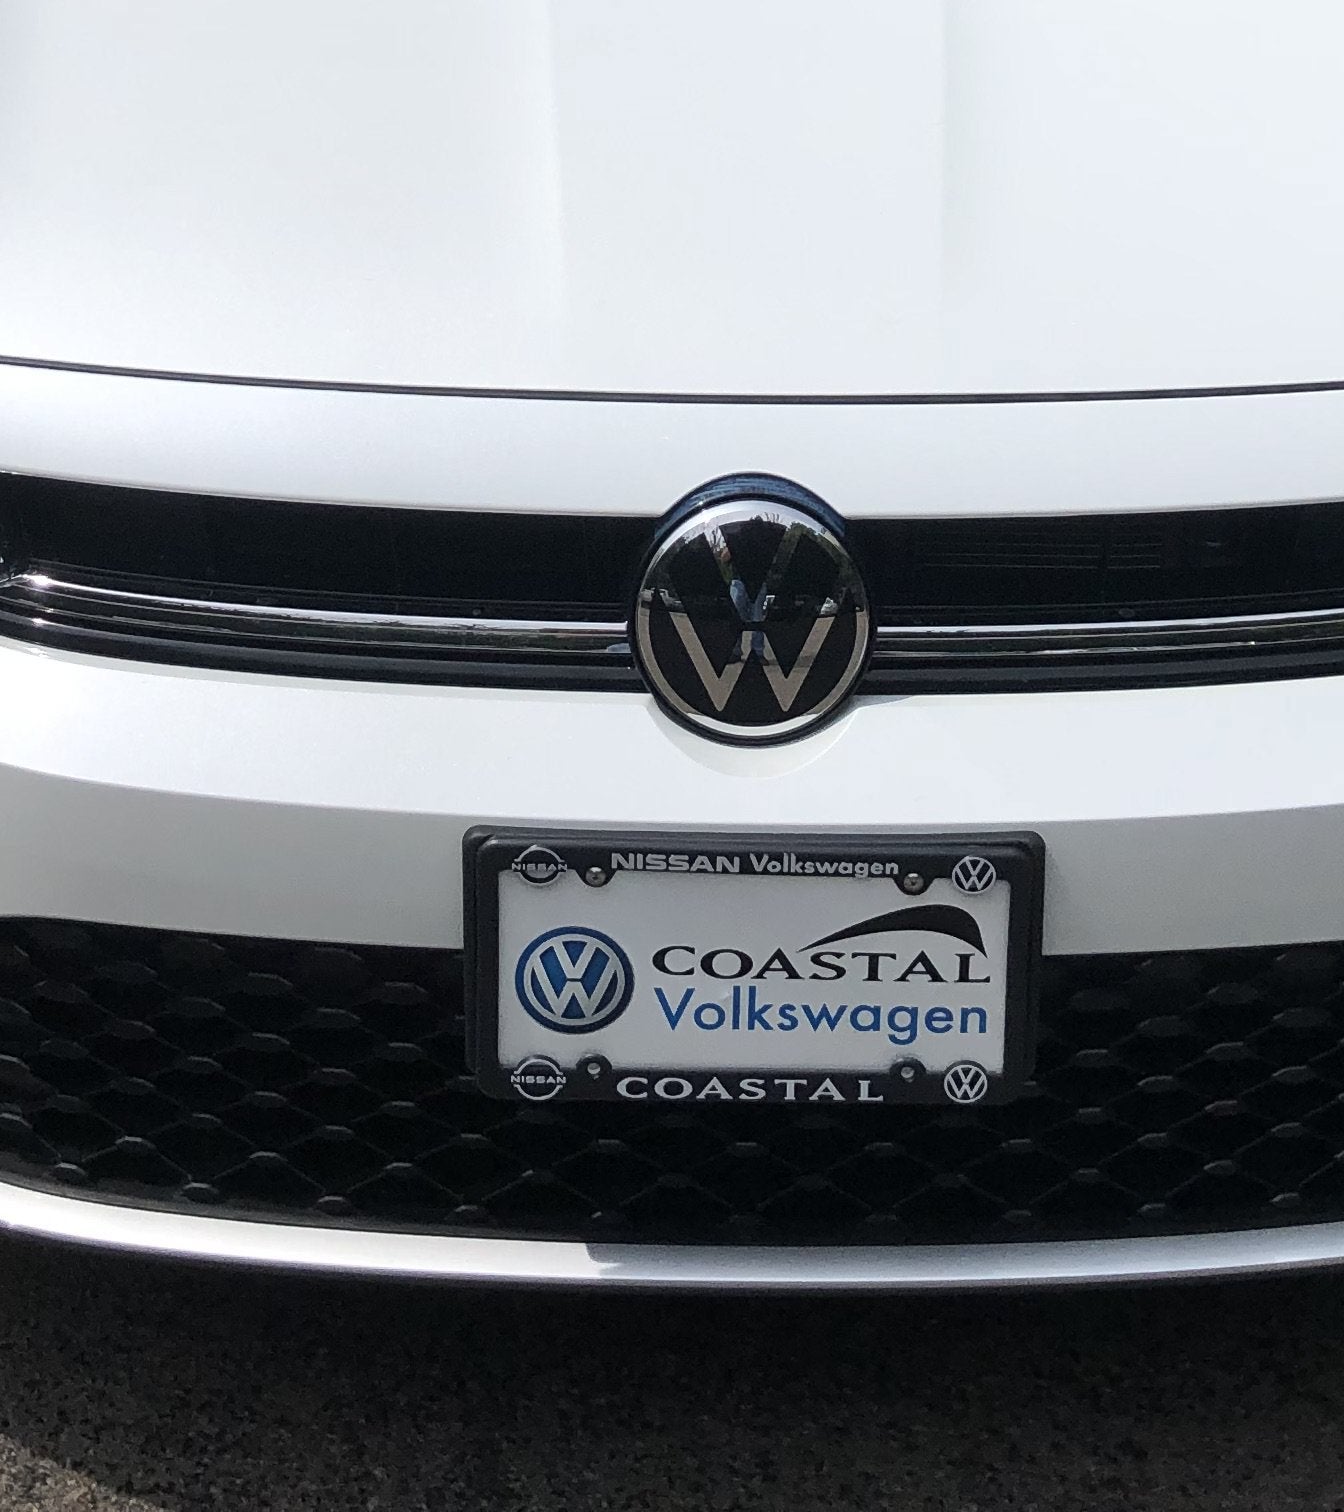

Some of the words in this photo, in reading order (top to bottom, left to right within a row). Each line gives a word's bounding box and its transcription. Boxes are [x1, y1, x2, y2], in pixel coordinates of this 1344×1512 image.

[511, 861, 568, 873] NISSAN
[610, 852, 741, 875] NISSAN
[748, 852, 900, 878] Volkswagen
[651, 945, 991, 985] COASTAL
[653, 985, 988, 1046] Volkswagen
[510, 1071, 567, 1085] NISSAN
[615, 1076, 885, 1103] COASTAL
